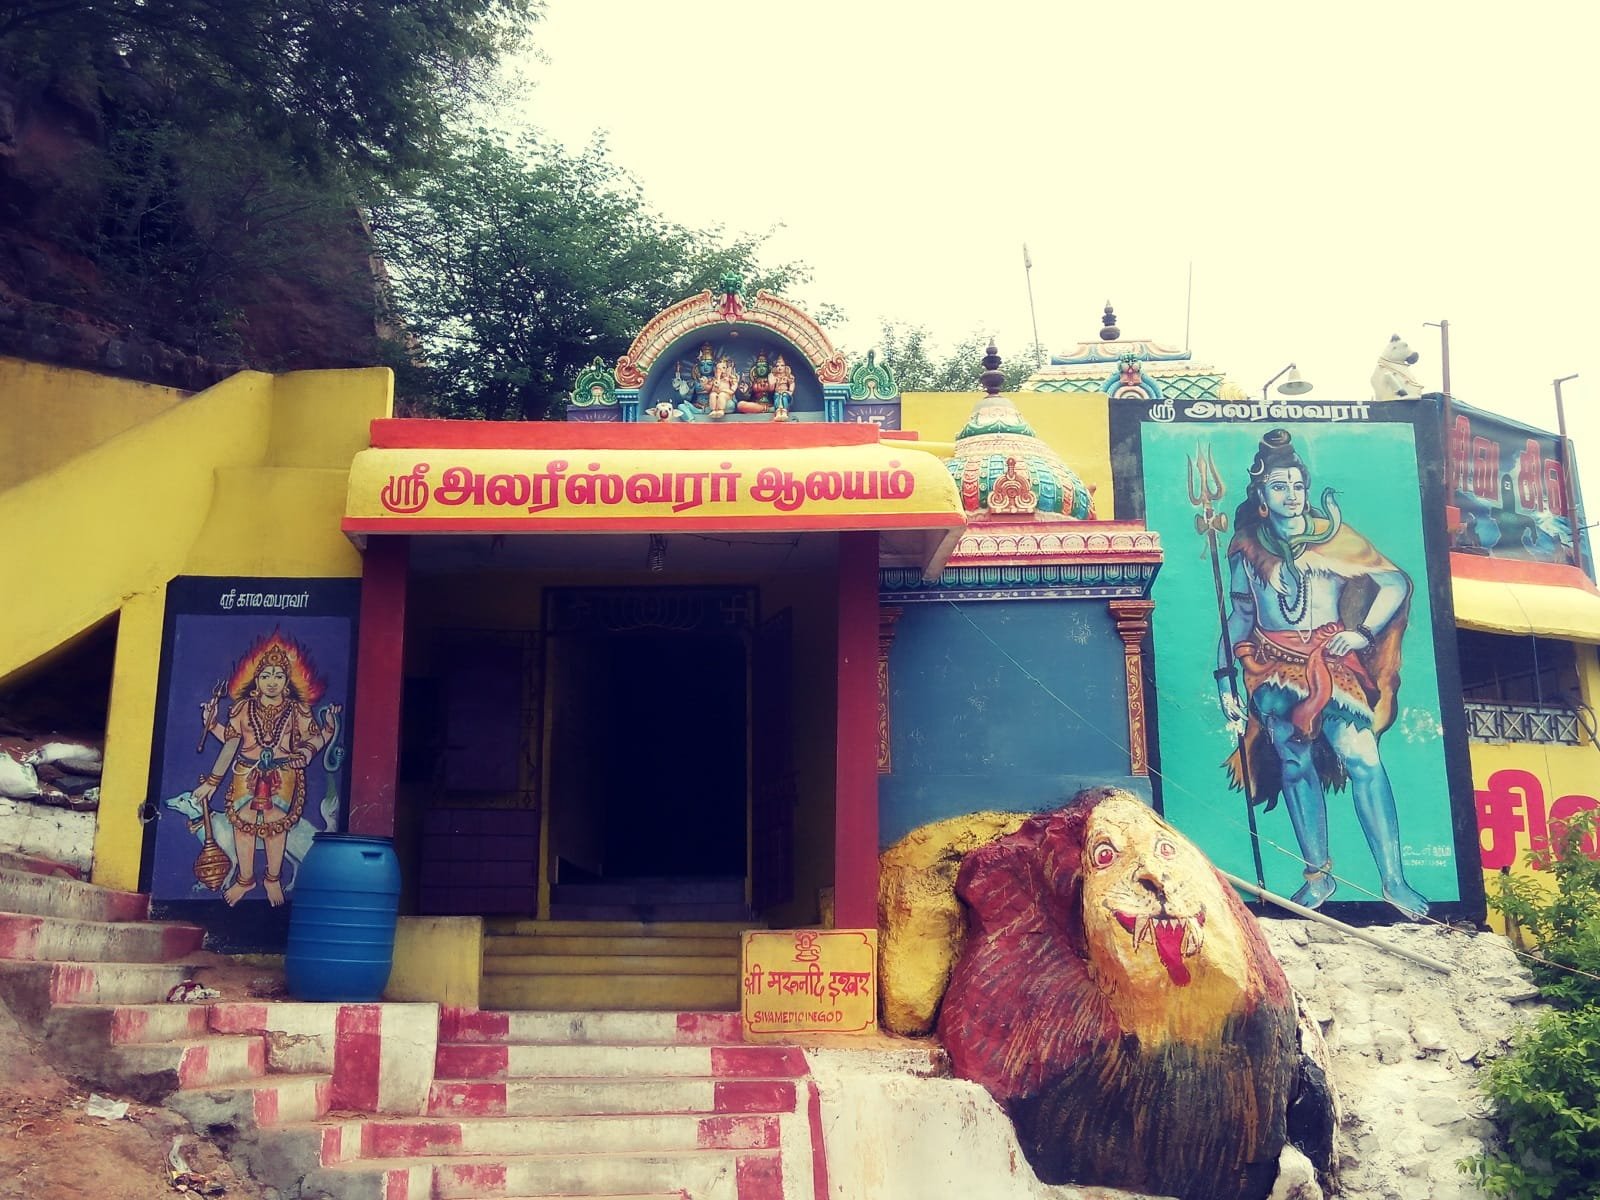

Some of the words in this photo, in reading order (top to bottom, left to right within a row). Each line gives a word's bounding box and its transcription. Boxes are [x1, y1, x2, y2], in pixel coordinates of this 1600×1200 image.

[1149, 400, 1176, 422] ஸ்ரீ
[381, 462, 430, 514] ஸ்ரீ
[433, 459, 742, 514] அலரீஸ்வரர்
[749, 459, 915, 512] ஆலயம்
[219, 588, 236, 610] ஸ்ரீ
[744, 963, 765, 996] श्री
